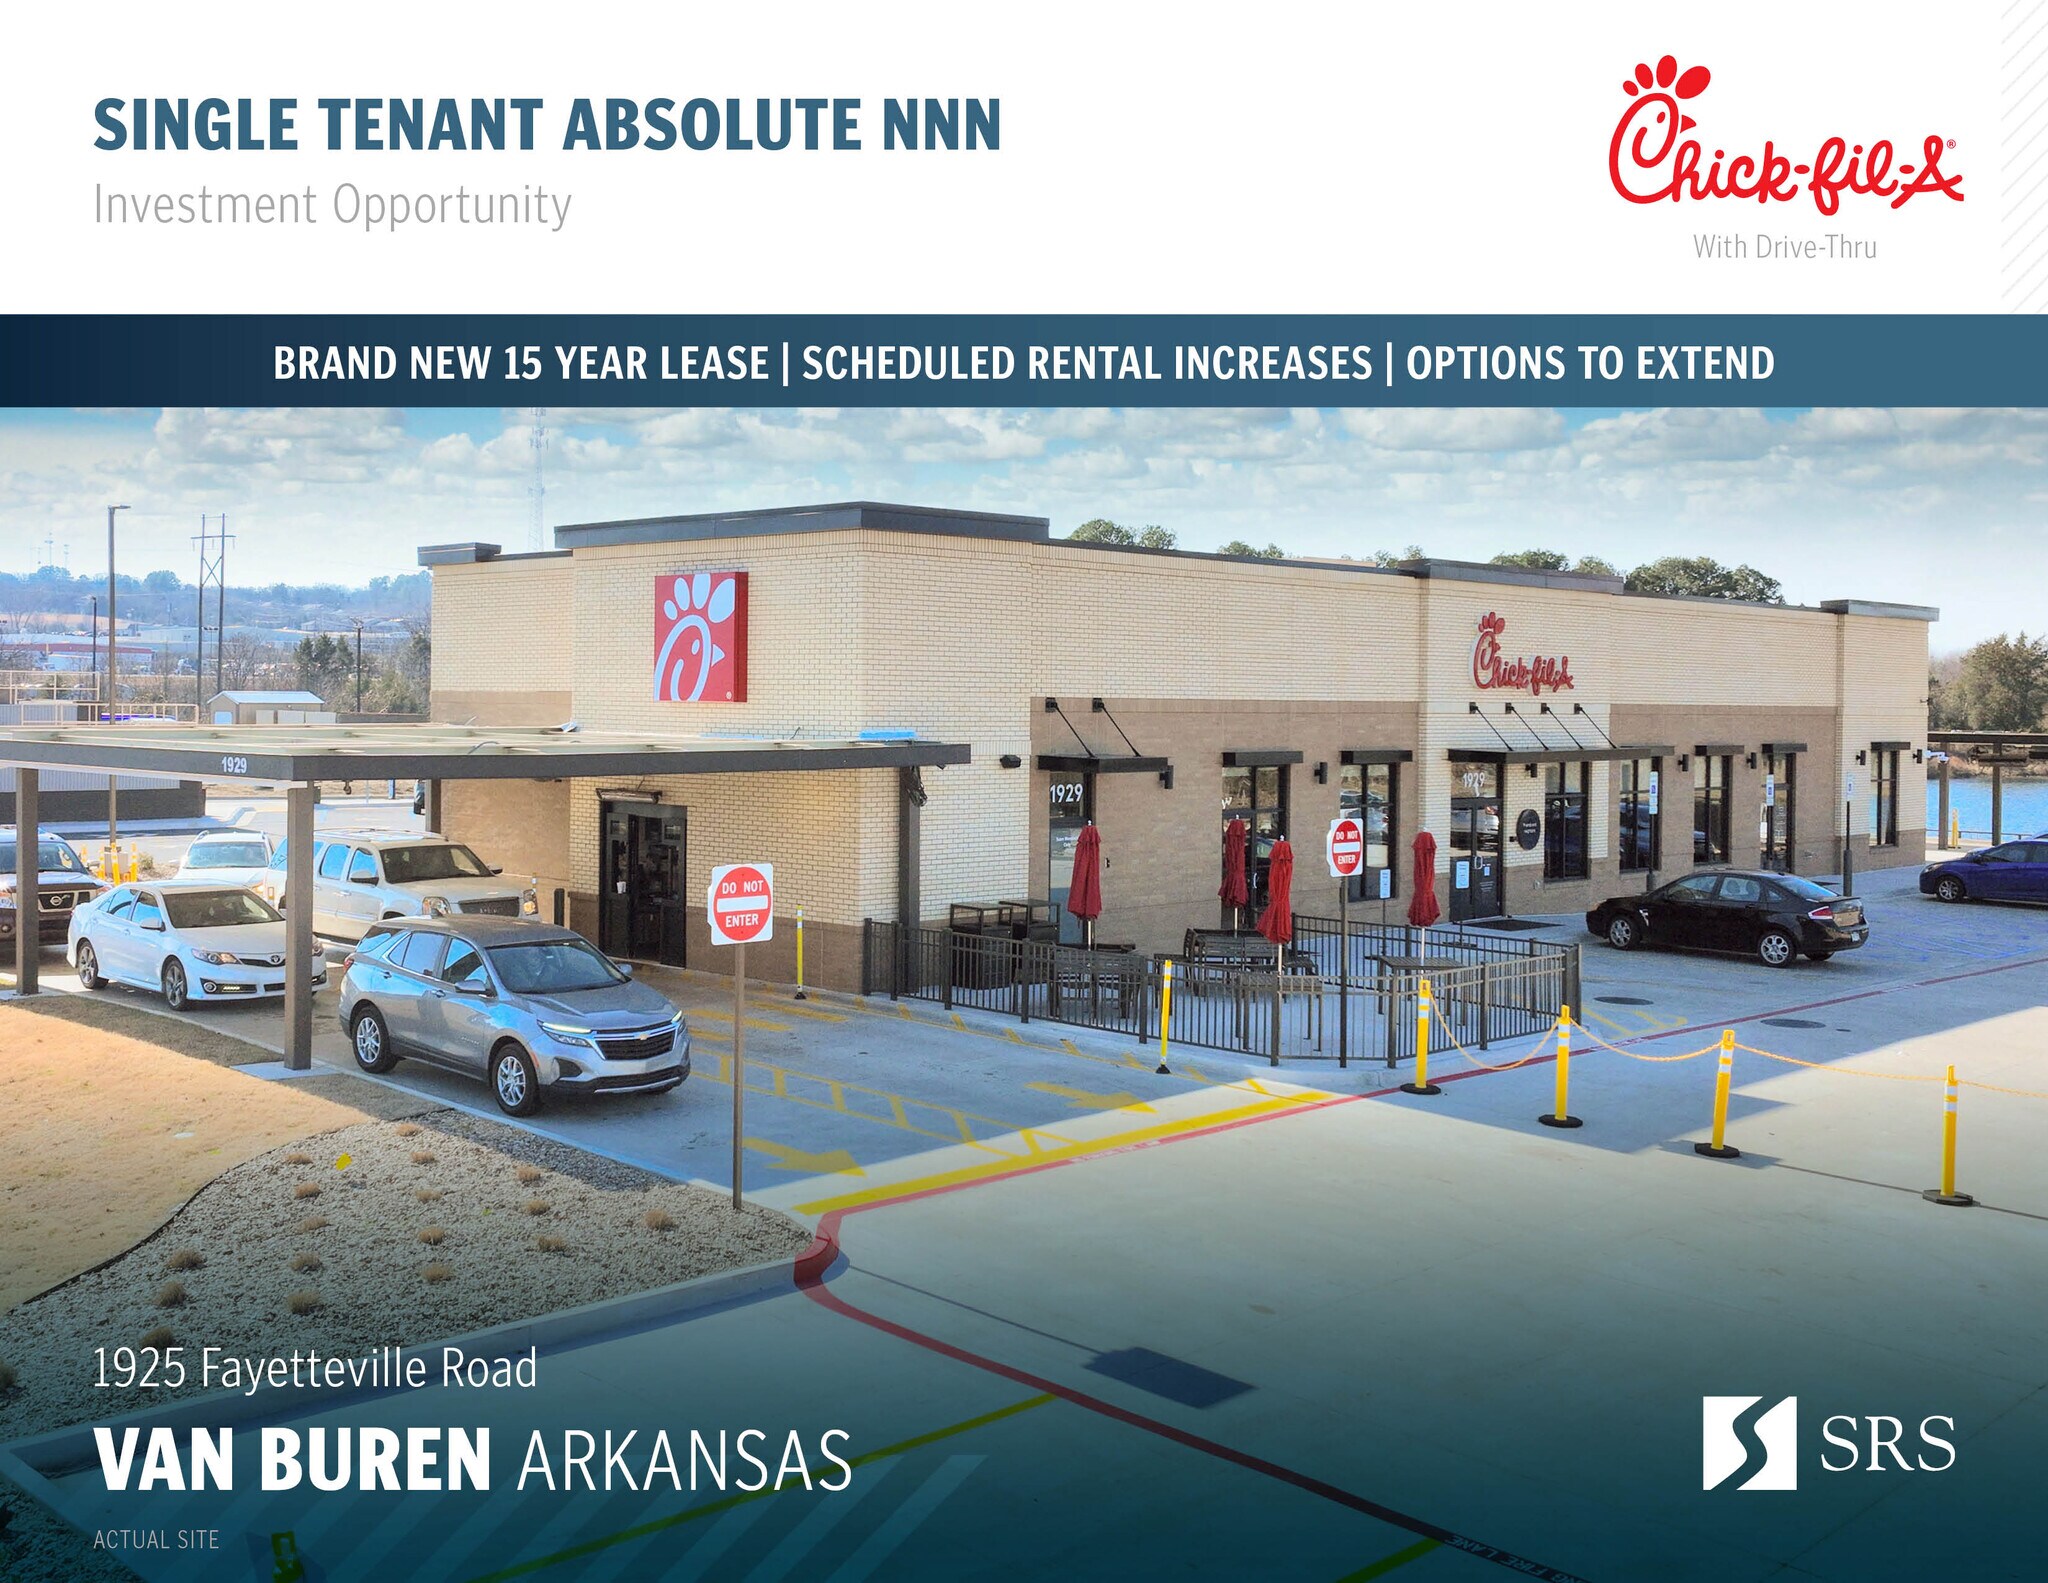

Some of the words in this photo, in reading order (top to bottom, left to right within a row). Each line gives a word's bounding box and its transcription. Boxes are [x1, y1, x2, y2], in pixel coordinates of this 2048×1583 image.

[1474, 631, 1574, 696] Chick-fil-A
[221, 756, 248, 774] 1929
[1050, 783, 1084, 803] 1929
[1335, 831, 1345, 840] DO
[1347, 830, 1359, 840] NOT
[1337, 854, 1356, 865] ENTER
[722, 881, 737, 895] DO
[743, 880, 764, 893] NOT
[725, 913, 759, 928] ENTER
